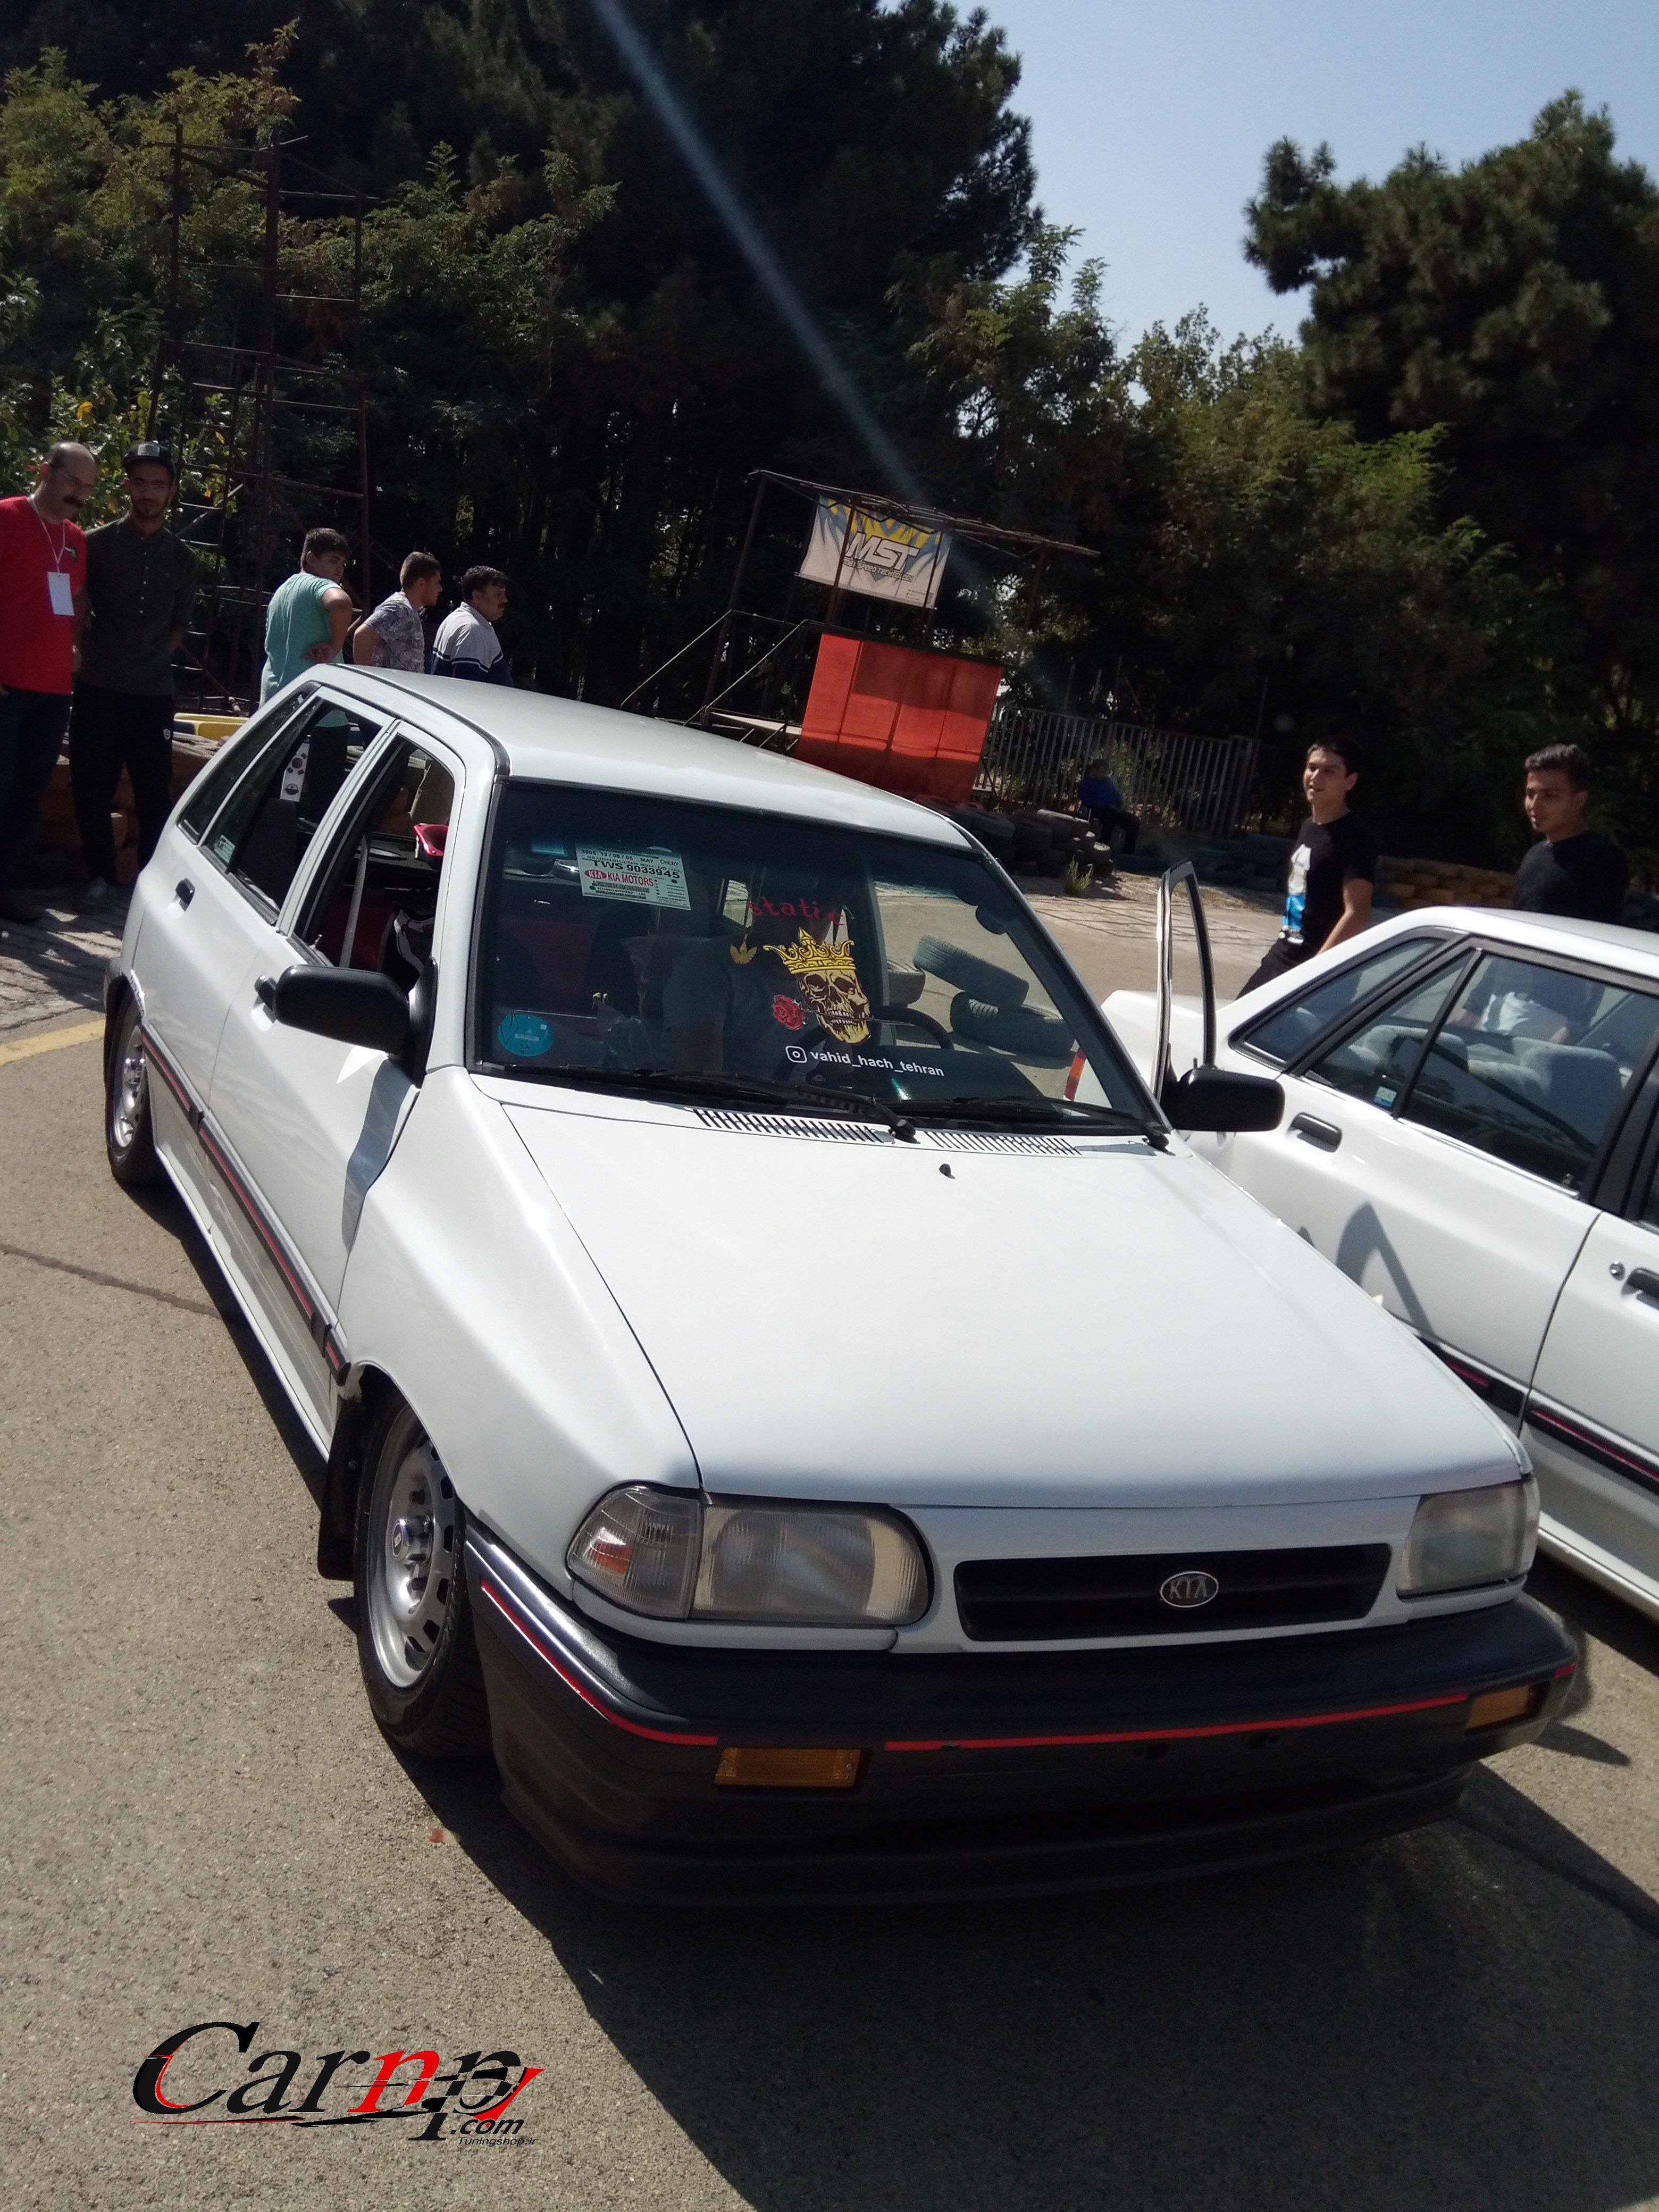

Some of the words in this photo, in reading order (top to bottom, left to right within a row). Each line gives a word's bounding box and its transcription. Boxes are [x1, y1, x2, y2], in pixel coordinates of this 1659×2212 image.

[844, 531, 920, 571] MST
[588, 870, 603, 878] KIA
[592, 860, 624, 870] TWS
[626, 864, 680, 878] 9033945
[608, 872, 621, 882] KIA
[622, 874, 654, 887] MOTORS
[810, 1051, 945, 1077] vahid_hach_tehran
[1169, 1576, 1209, 1600] KIA
